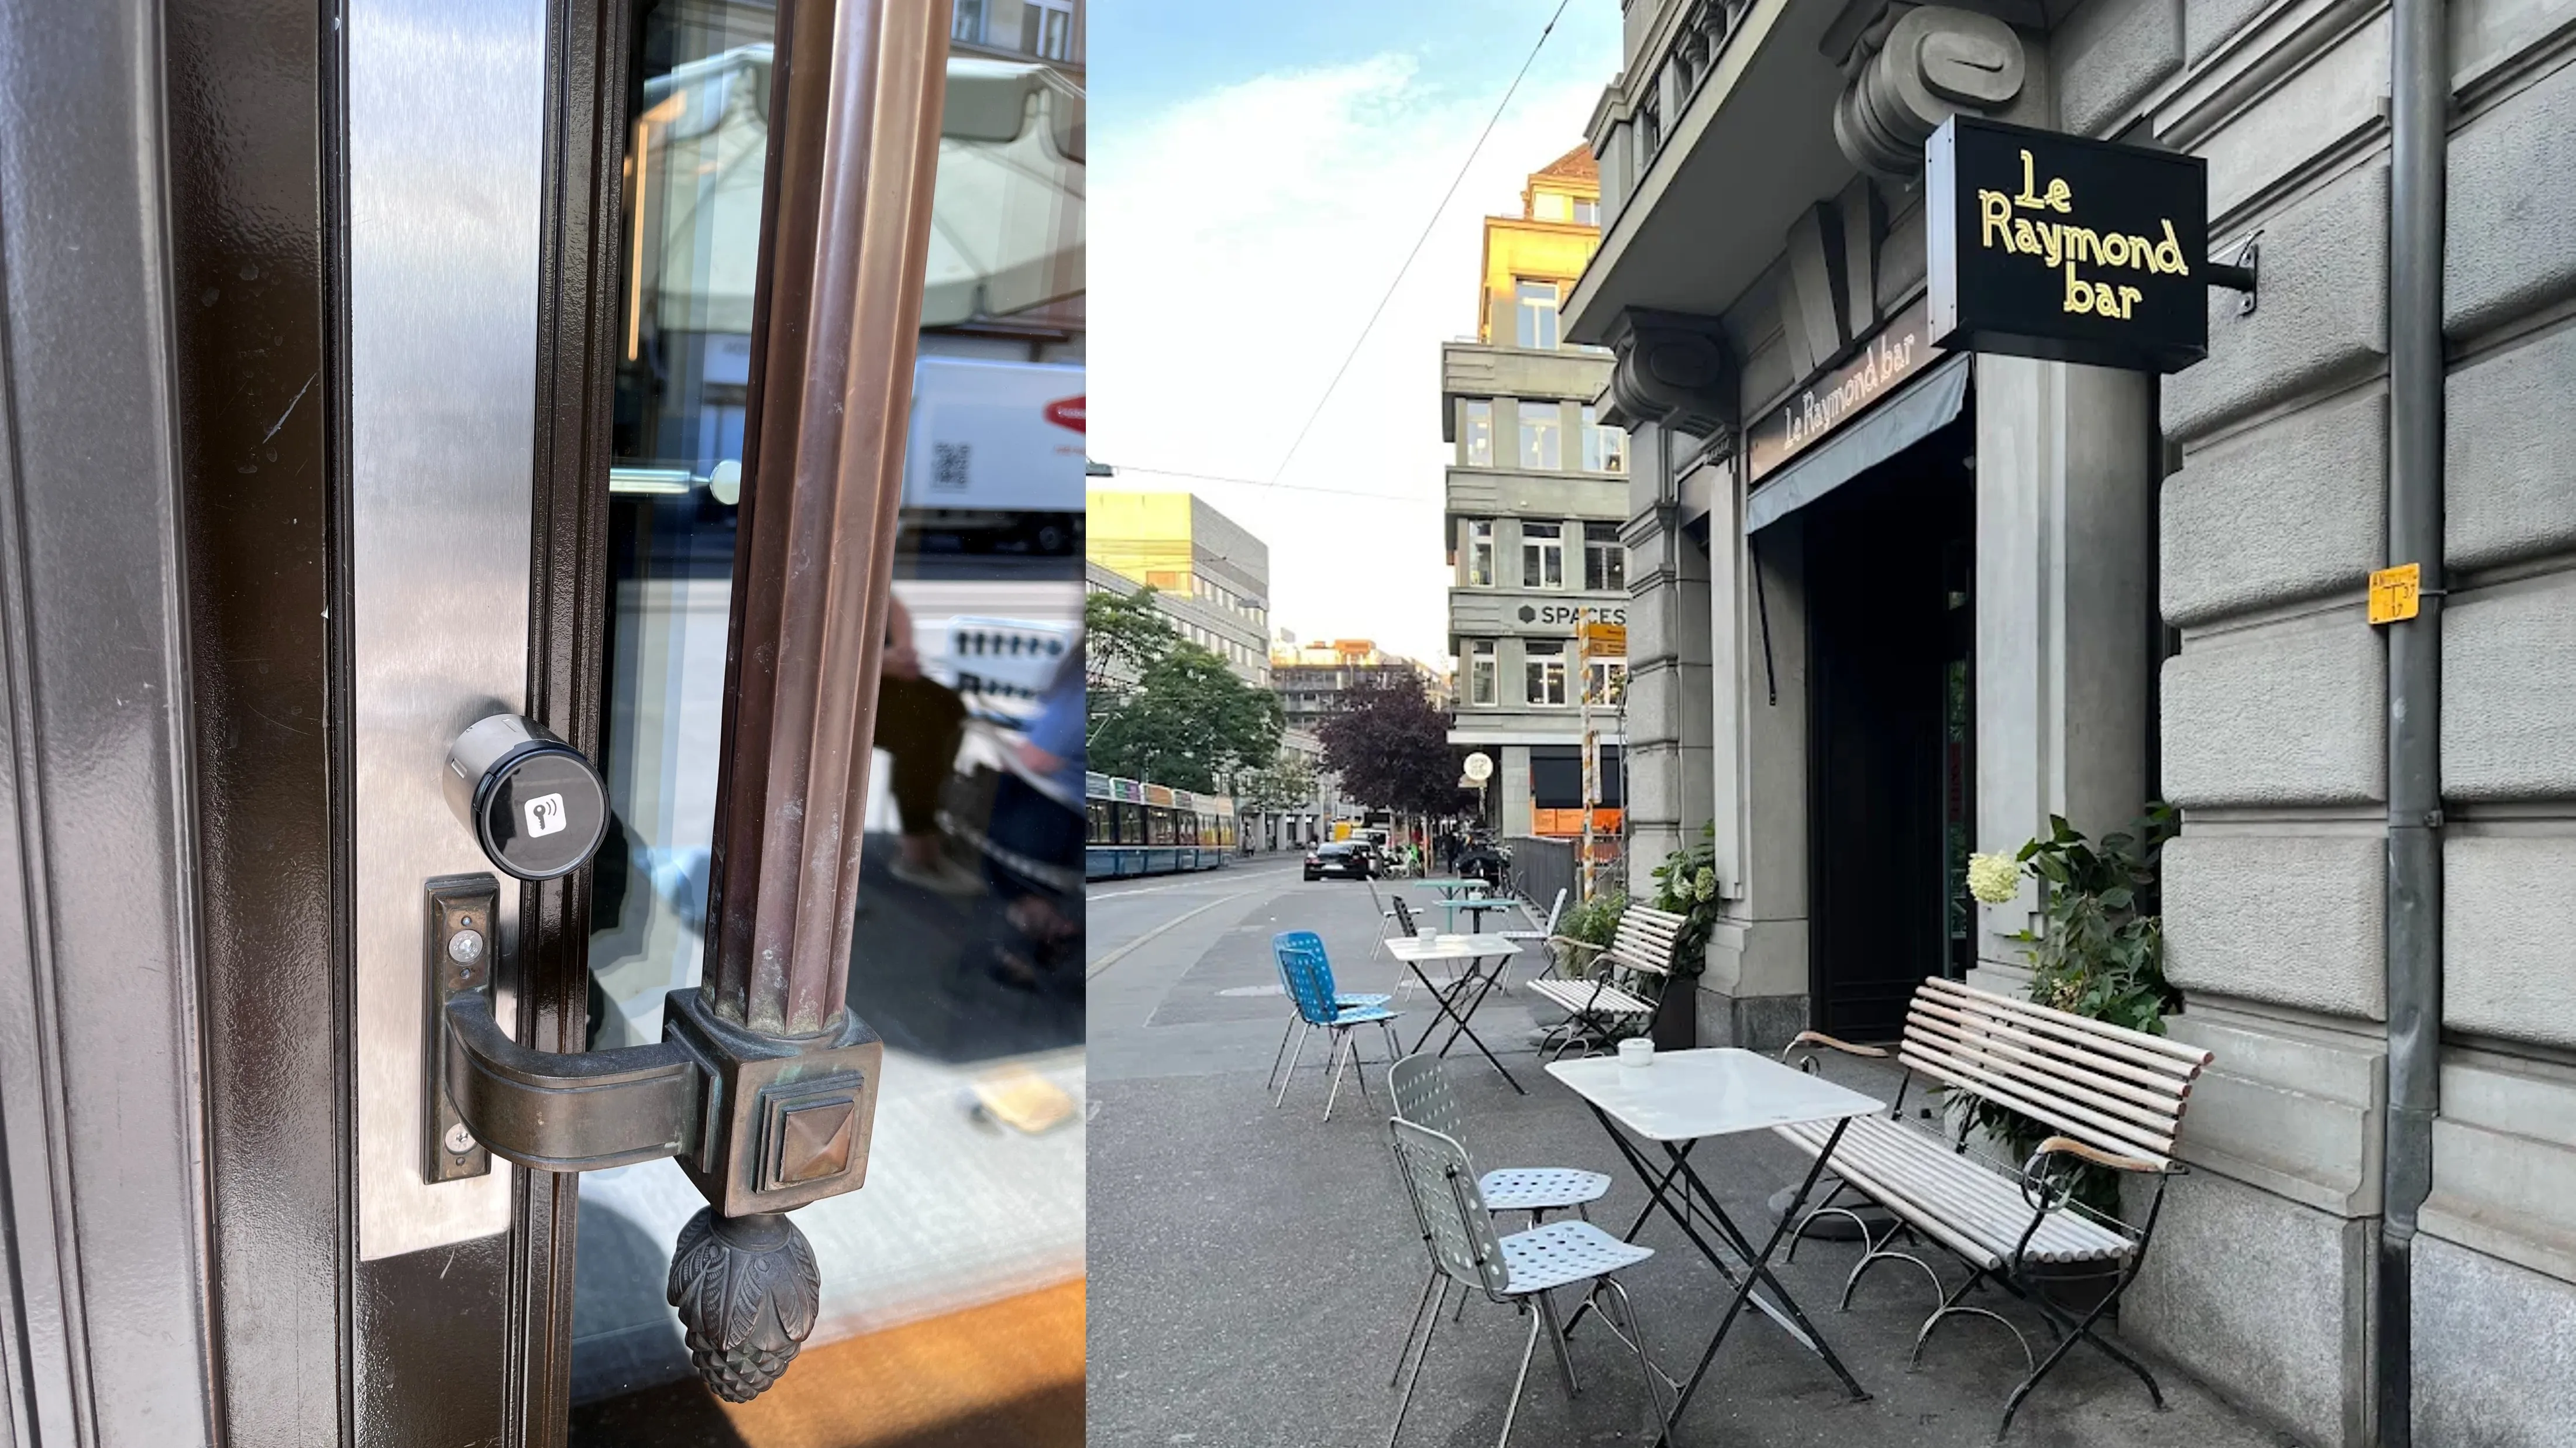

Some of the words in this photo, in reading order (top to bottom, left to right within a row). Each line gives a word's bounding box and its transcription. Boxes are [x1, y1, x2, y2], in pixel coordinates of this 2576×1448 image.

[2014, 149, 2072, 213] Le
[1978, 189, 2189, 276] Raymond
[2063, 261, 2142, 319] bar
[1784, 407, 1802, 450] Le
[1803, 345, 1878, 431] Raymond
[1880, 333, 1915, 383] bar
